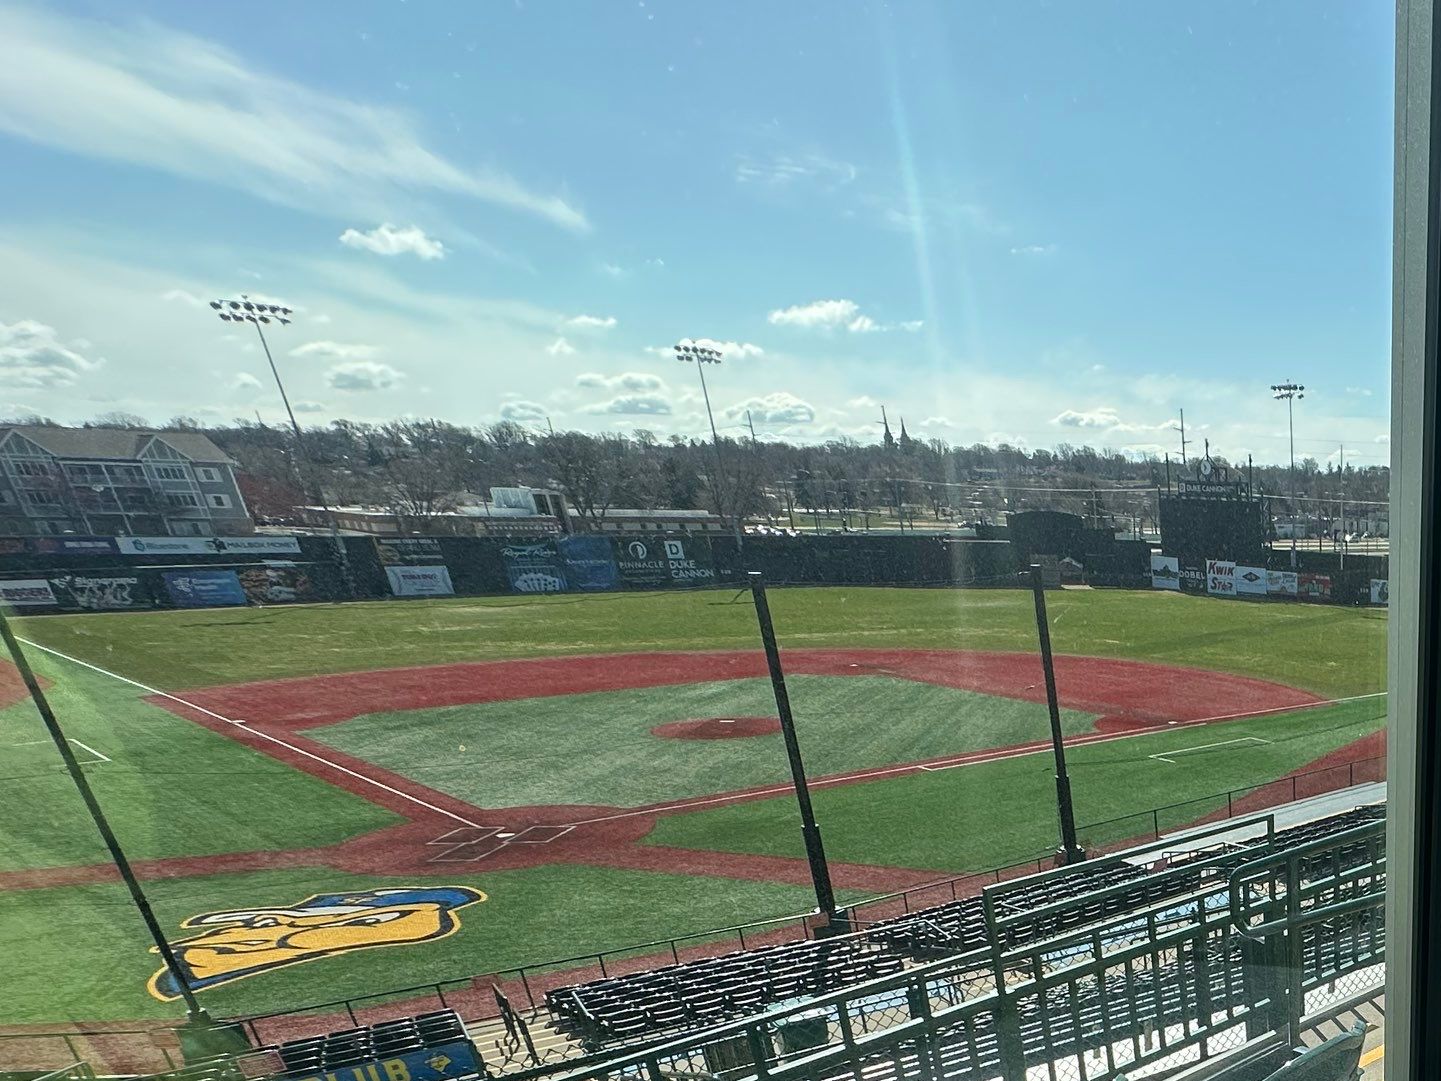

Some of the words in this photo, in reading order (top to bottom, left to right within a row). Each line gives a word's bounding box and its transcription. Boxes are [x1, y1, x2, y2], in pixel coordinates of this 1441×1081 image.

[619, 560, 665, 570] PINNACLE
[668, 560, 696, 569] DUKE
[1207, 561, 1235, 576] KWIK
[671, 569, 715, 579] CANNON
